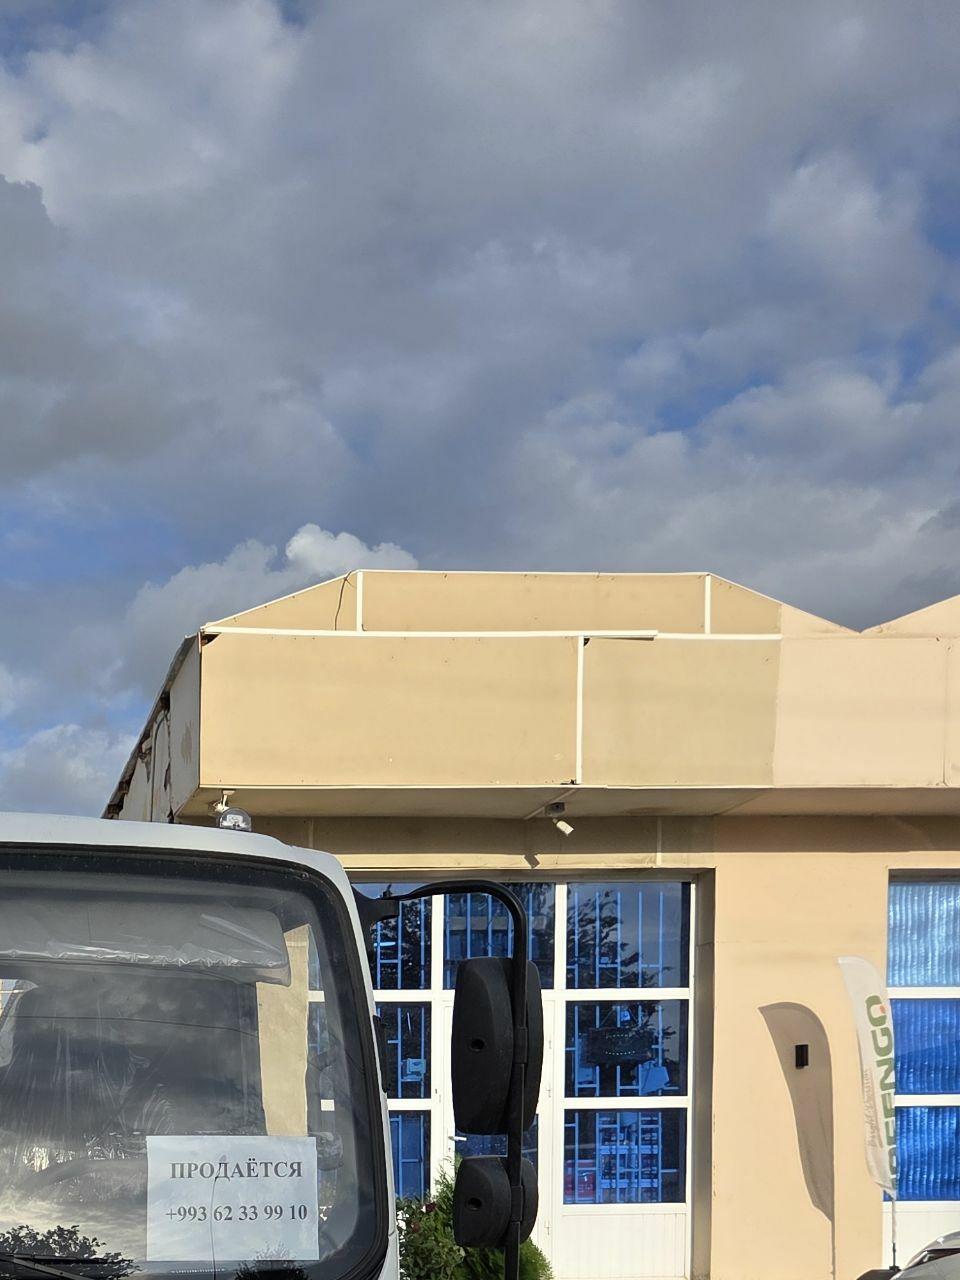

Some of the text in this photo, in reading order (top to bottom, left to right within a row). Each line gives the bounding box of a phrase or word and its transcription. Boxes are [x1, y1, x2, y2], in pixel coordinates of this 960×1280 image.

[170, 1157, 303, 1182] ПРОДАЁТСЯ
[165, 1204, 308, 1221] +993 62 33 99 10
